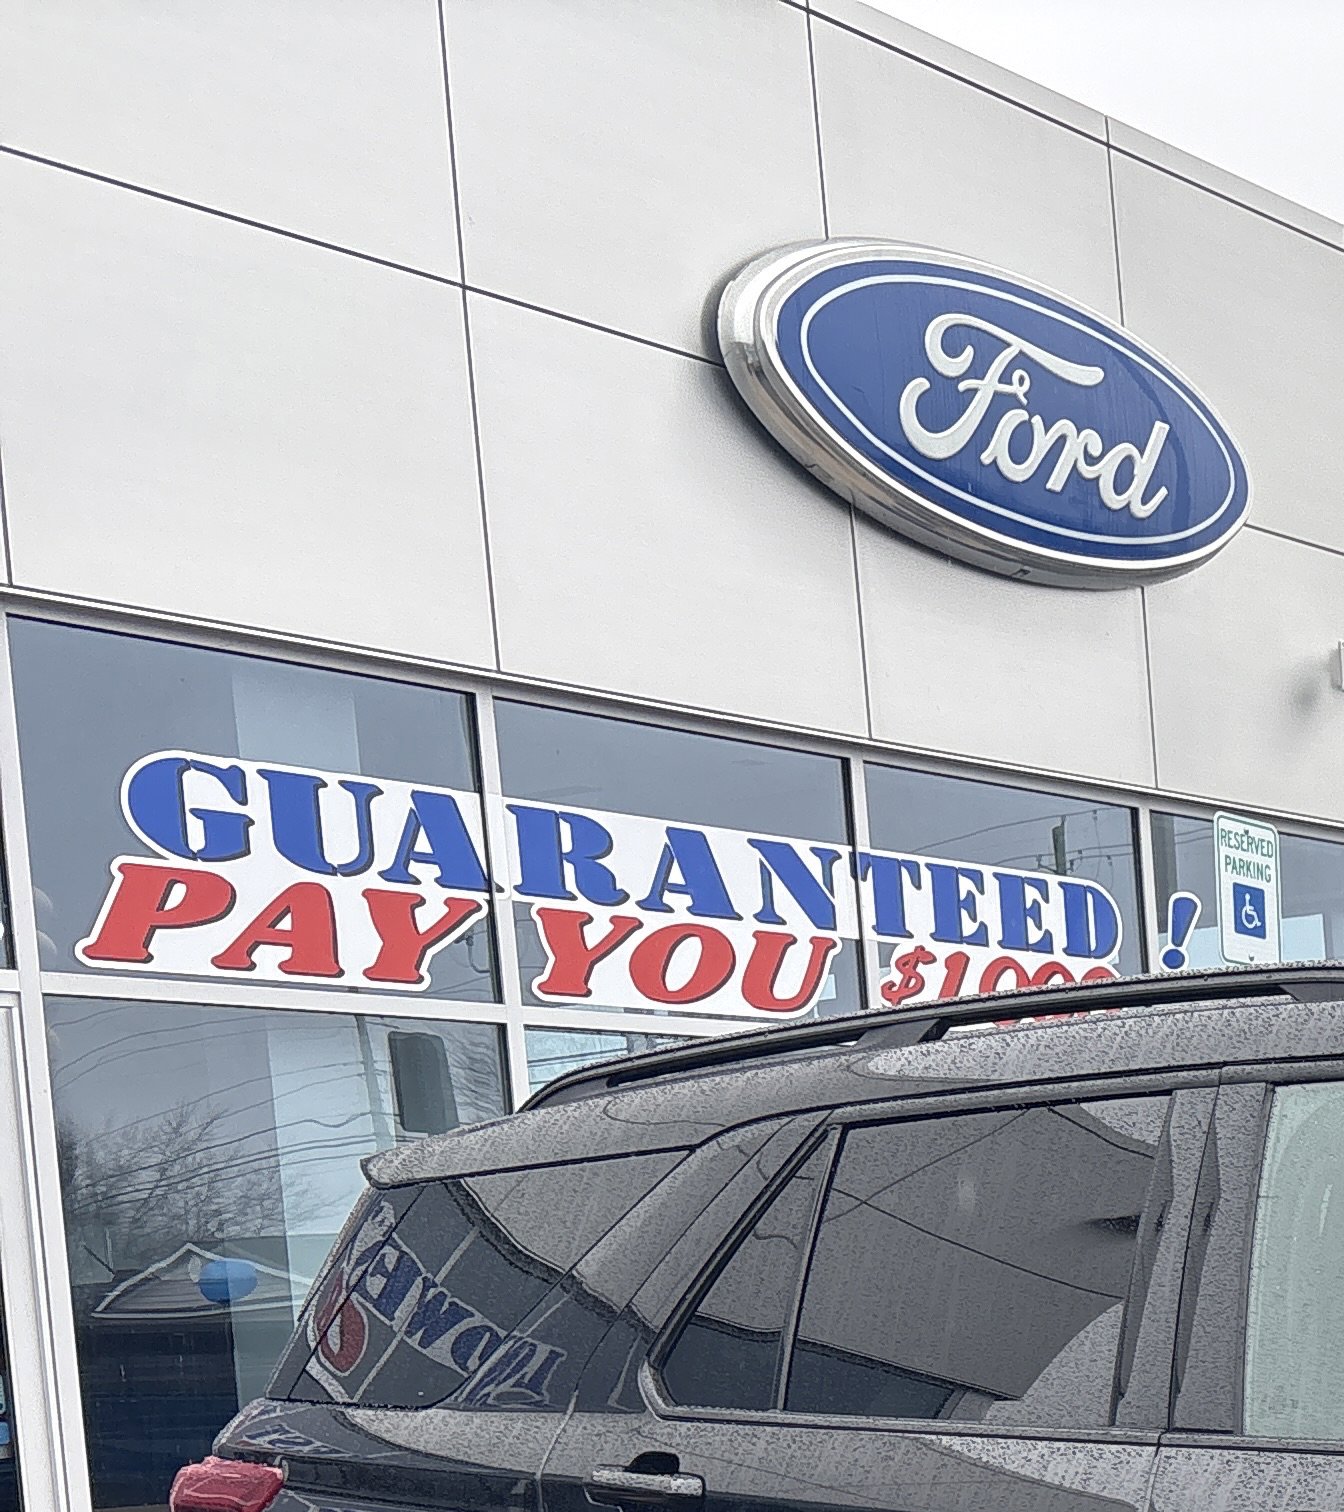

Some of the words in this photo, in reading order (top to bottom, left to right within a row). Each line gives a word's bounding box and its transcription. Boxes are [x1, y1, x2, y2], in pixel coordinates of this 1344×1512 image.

[899, 312, 1171, 520] Ford
[127, 756, 1121, 960] GUARANTEED
[1220, 827, 1274, 859] RESERVED
[1225, 854, 1272, 883] PARKING
[82, 862, 482, 983] PAY
[536, 906, 837, 1011] YOU
